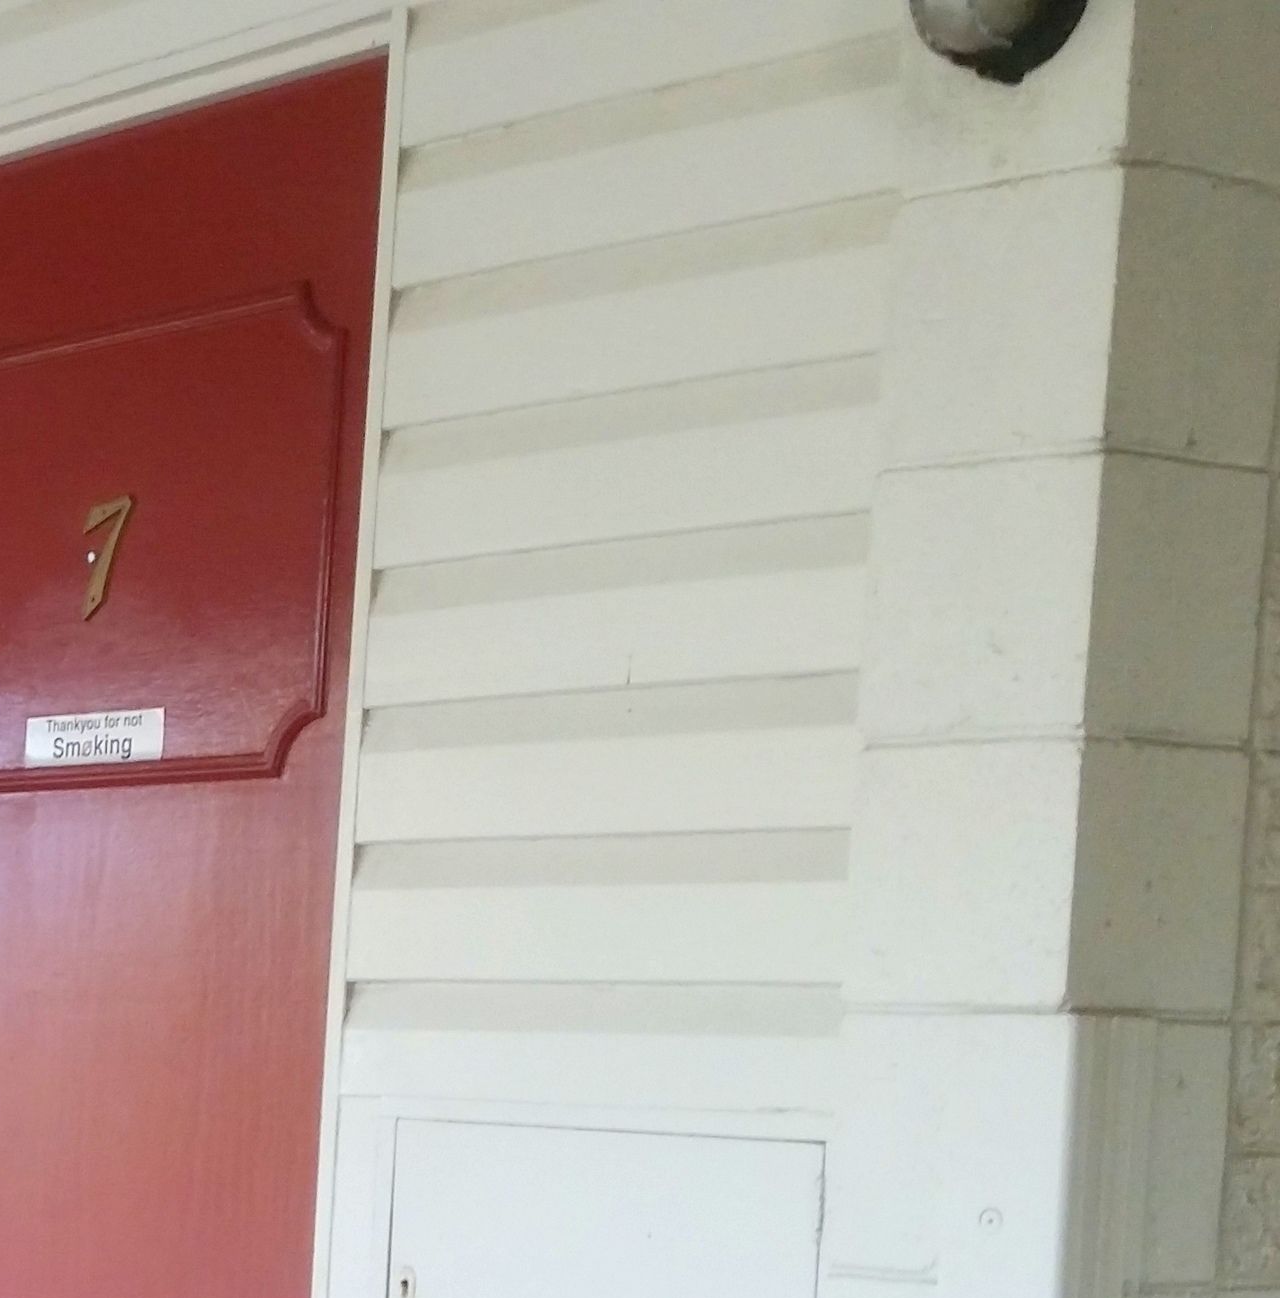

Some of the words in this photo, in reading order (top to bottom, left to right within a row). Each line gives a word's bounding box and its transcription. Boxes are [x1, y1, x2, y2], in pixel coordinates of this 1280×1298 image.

[83, 495, 132, 621] 7
[46, 718, 101, 734] Thankyou
[104, 715, 120, 728] for
[123, 715, 143, 727] not
[52, 734, 133, 759] Smoking
